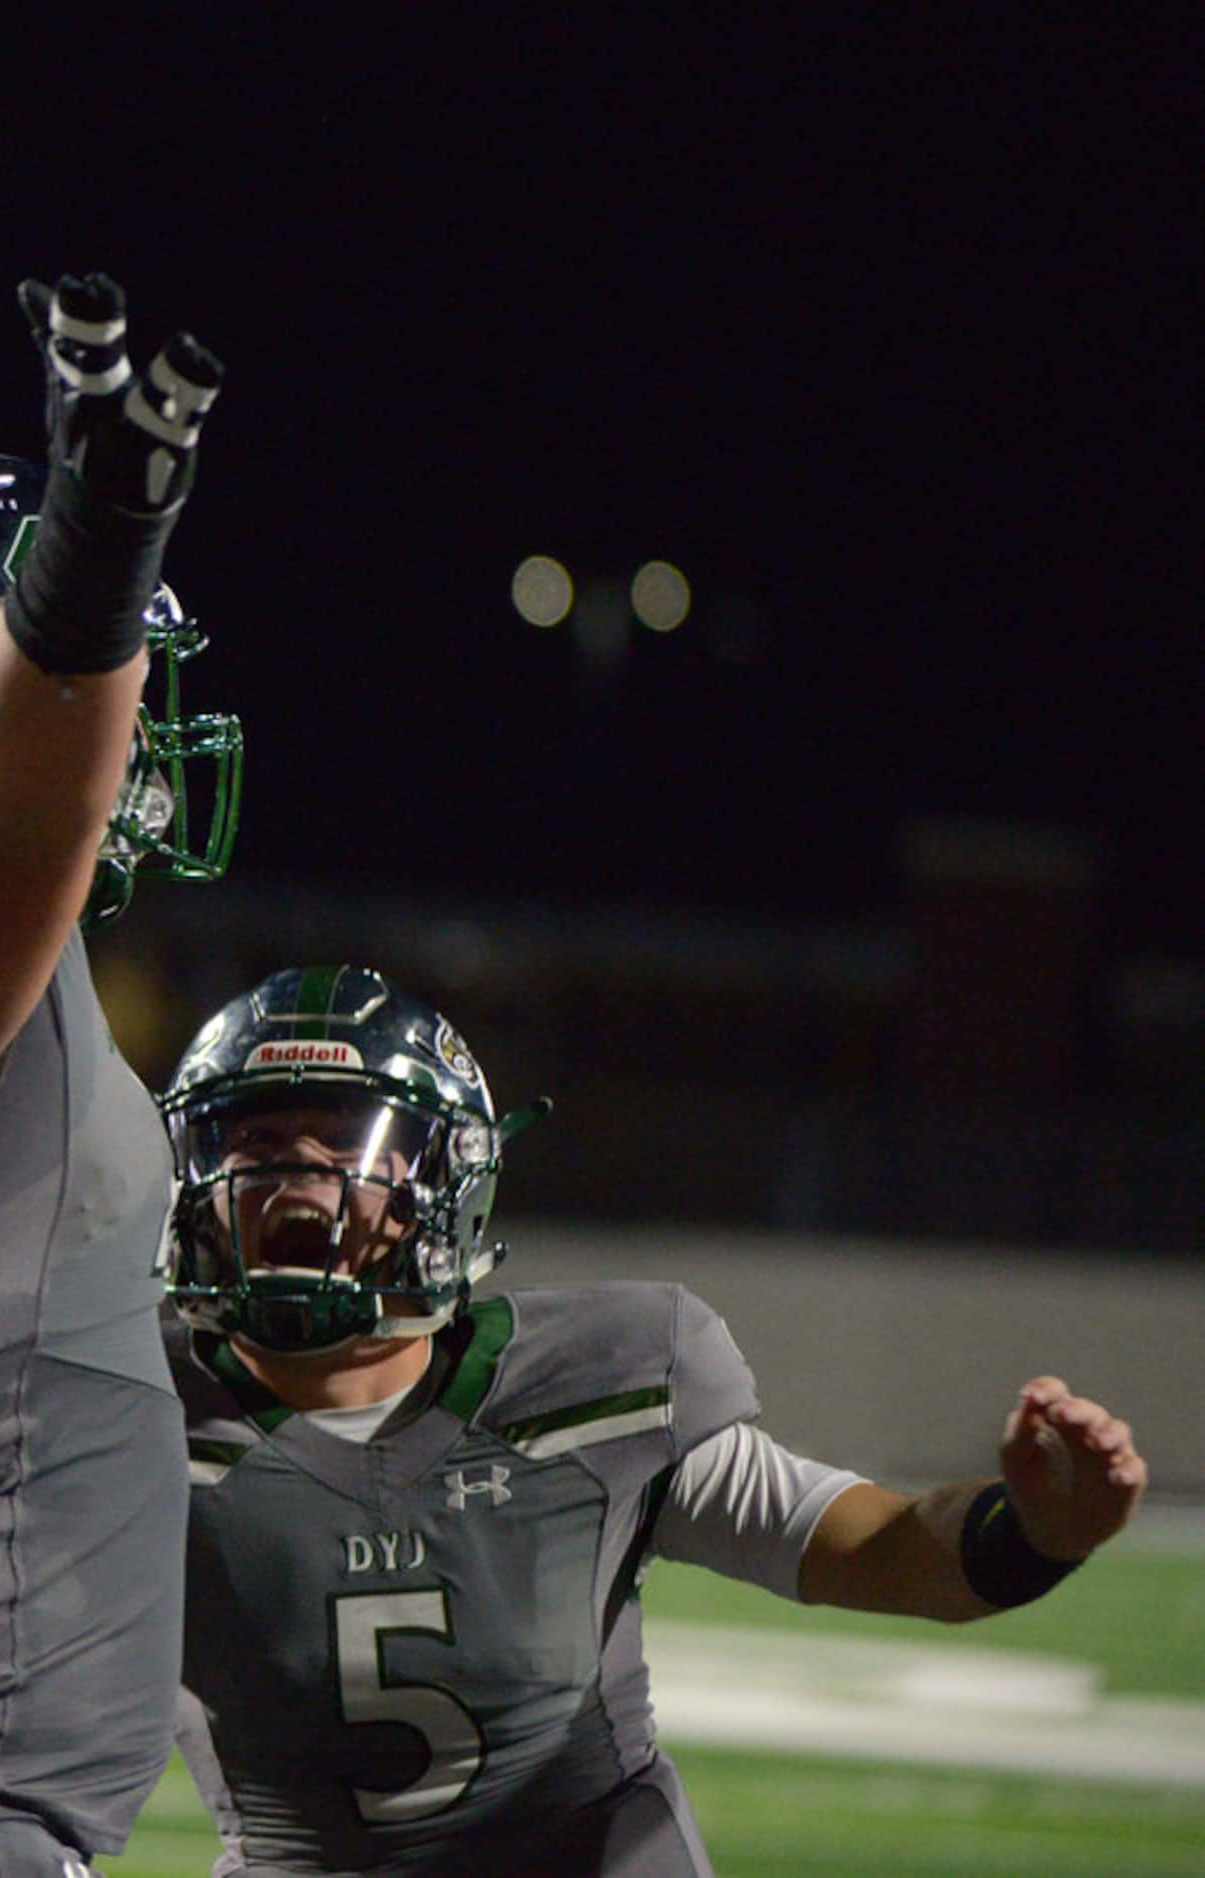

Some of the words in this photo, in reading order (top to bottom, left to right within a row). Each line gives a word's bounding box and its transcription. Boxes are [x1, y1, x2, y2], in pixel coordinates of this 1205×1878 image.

[260, 1045, 347, 1063] Riddell
[345, 1531, 427, 1573] DYJ
[327, 1586, 488, 1826] 5
